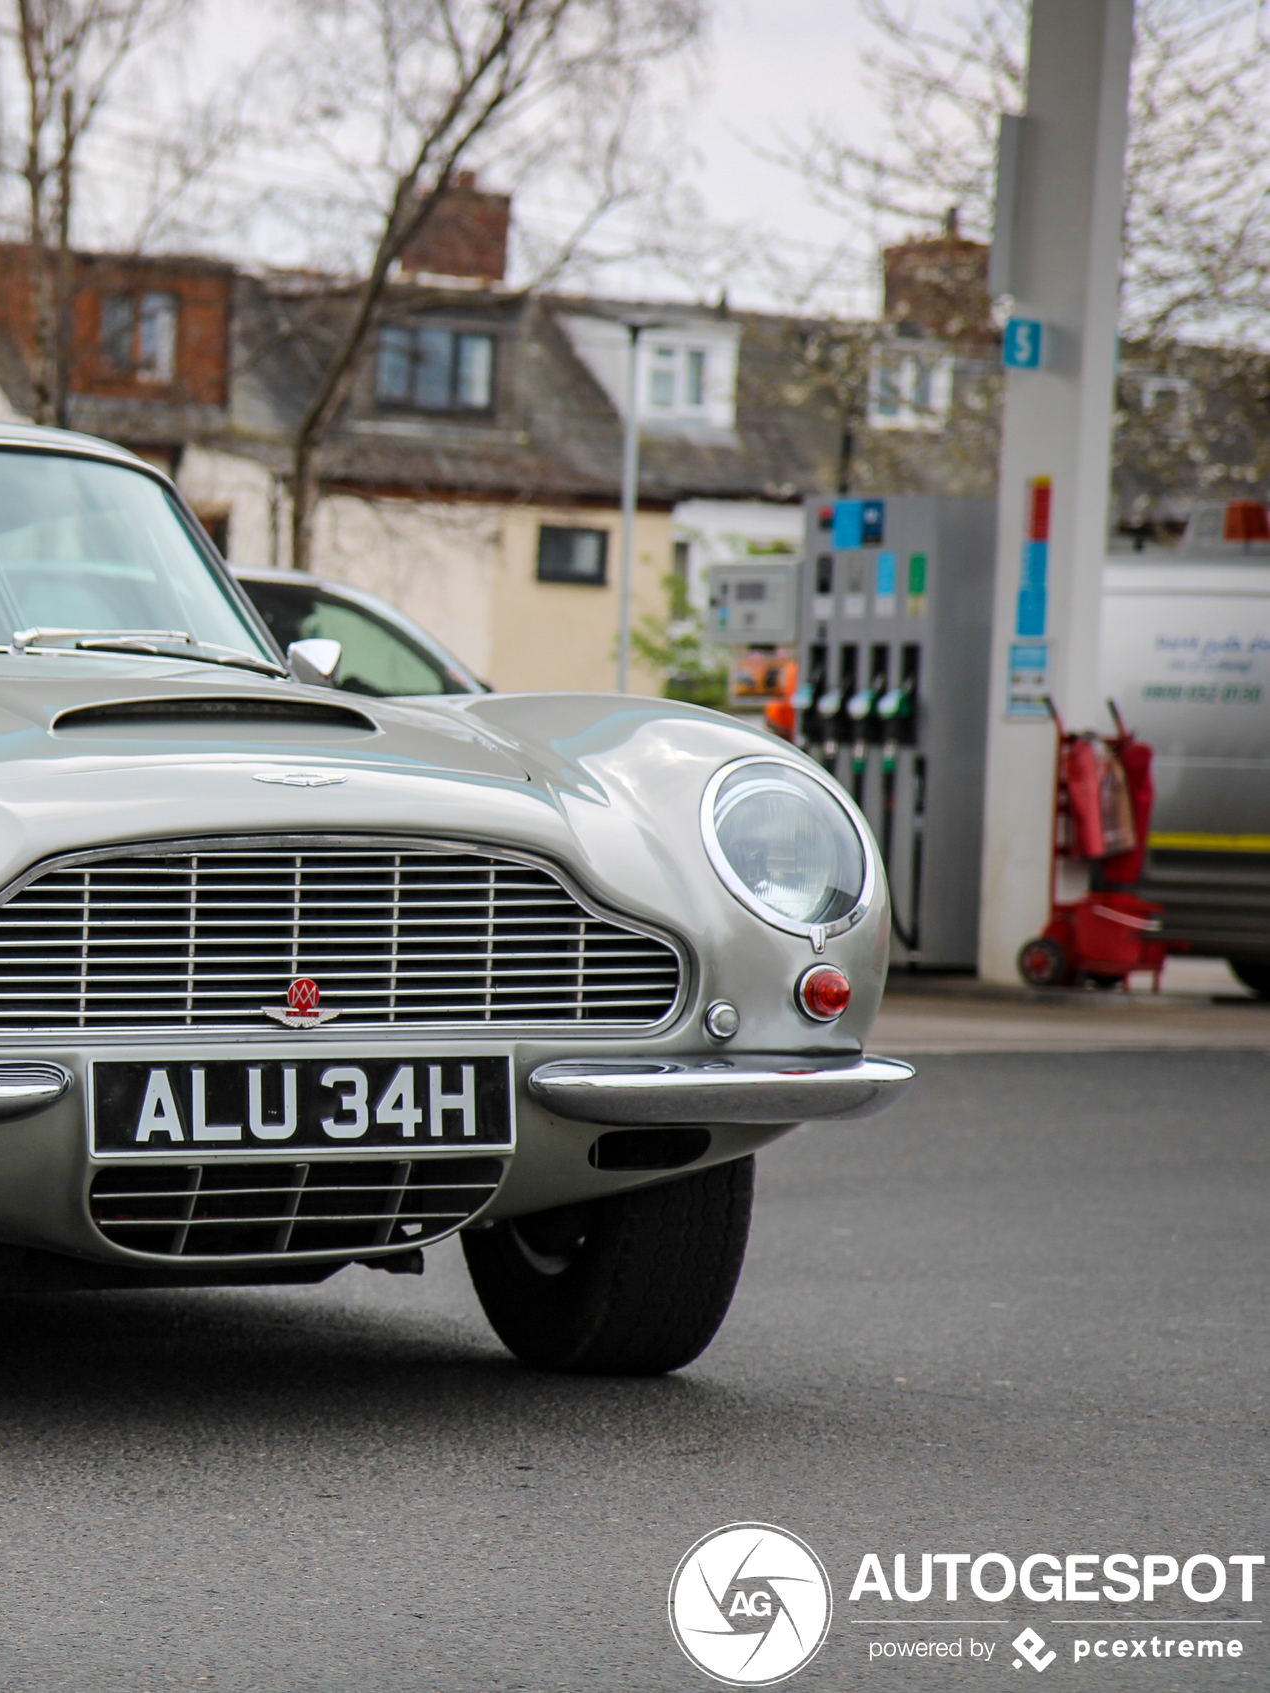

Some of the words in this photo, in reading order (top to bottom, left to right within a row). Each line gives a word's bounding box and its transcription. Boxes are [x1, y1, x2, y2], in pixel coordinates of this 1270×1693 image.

[1014, 324, 1032, 362] 5
[135, 1067, 298, 1142] ALU
[320, 1064, 477, 1139] 34H
